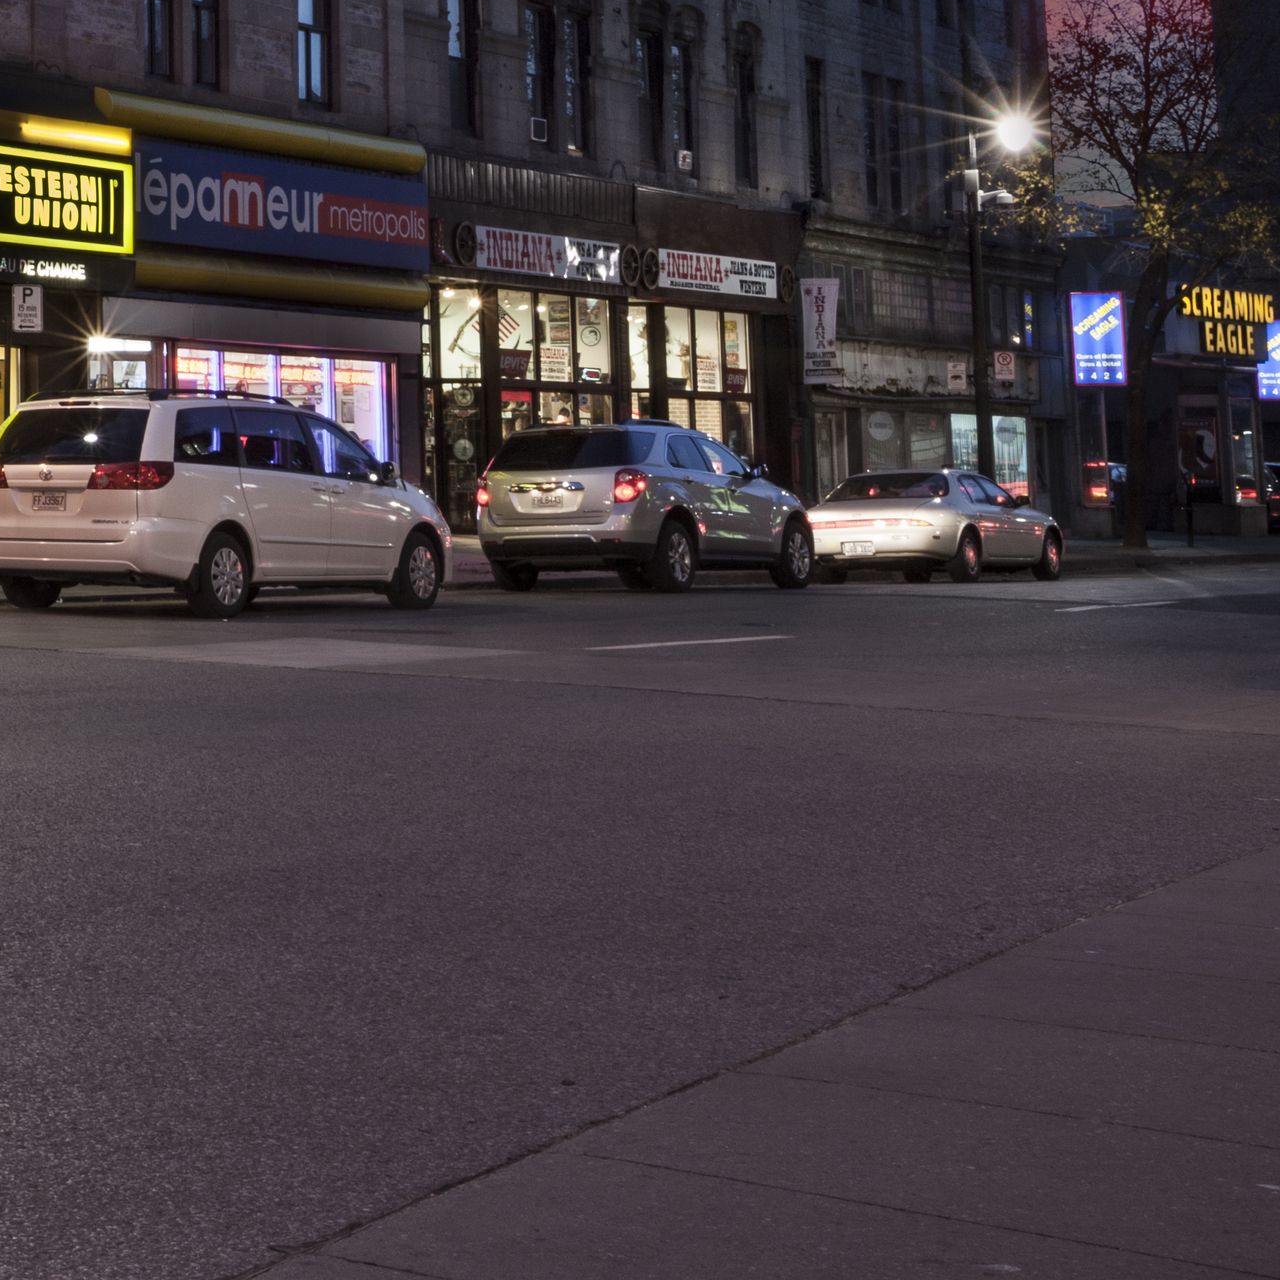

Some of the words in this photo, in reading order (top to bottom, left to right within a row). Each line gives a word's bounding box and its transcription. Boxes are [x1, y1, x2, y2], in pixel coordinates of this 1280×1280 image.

[14, 195, 98, 233] UNION
[135, 152, 324, 234] épanneur
[329, 203, 426, 242] metropolis
[486, 229, 556, 273] INDIANA
[666, 252, 724, 283] INDIANA
[20, 258, 35, 276] DE
[36, 260, 86, 281] CHANGE
[729, 261, 748, 277] JEANS
[753, 263, 776, 279] BOTTES
[23, 287, 34, 304] P
[739, 279, 767, 296] WESTERN
[1181, 284, 1274, 324] SCREAMING
[814, 286, 826, 350] INDIANA
[1073, 297, 1120, 336] SCREAMING
[1089, 315, 1120, 341] EAGLE
[1204, 321, 1255, 355] EAGLE
